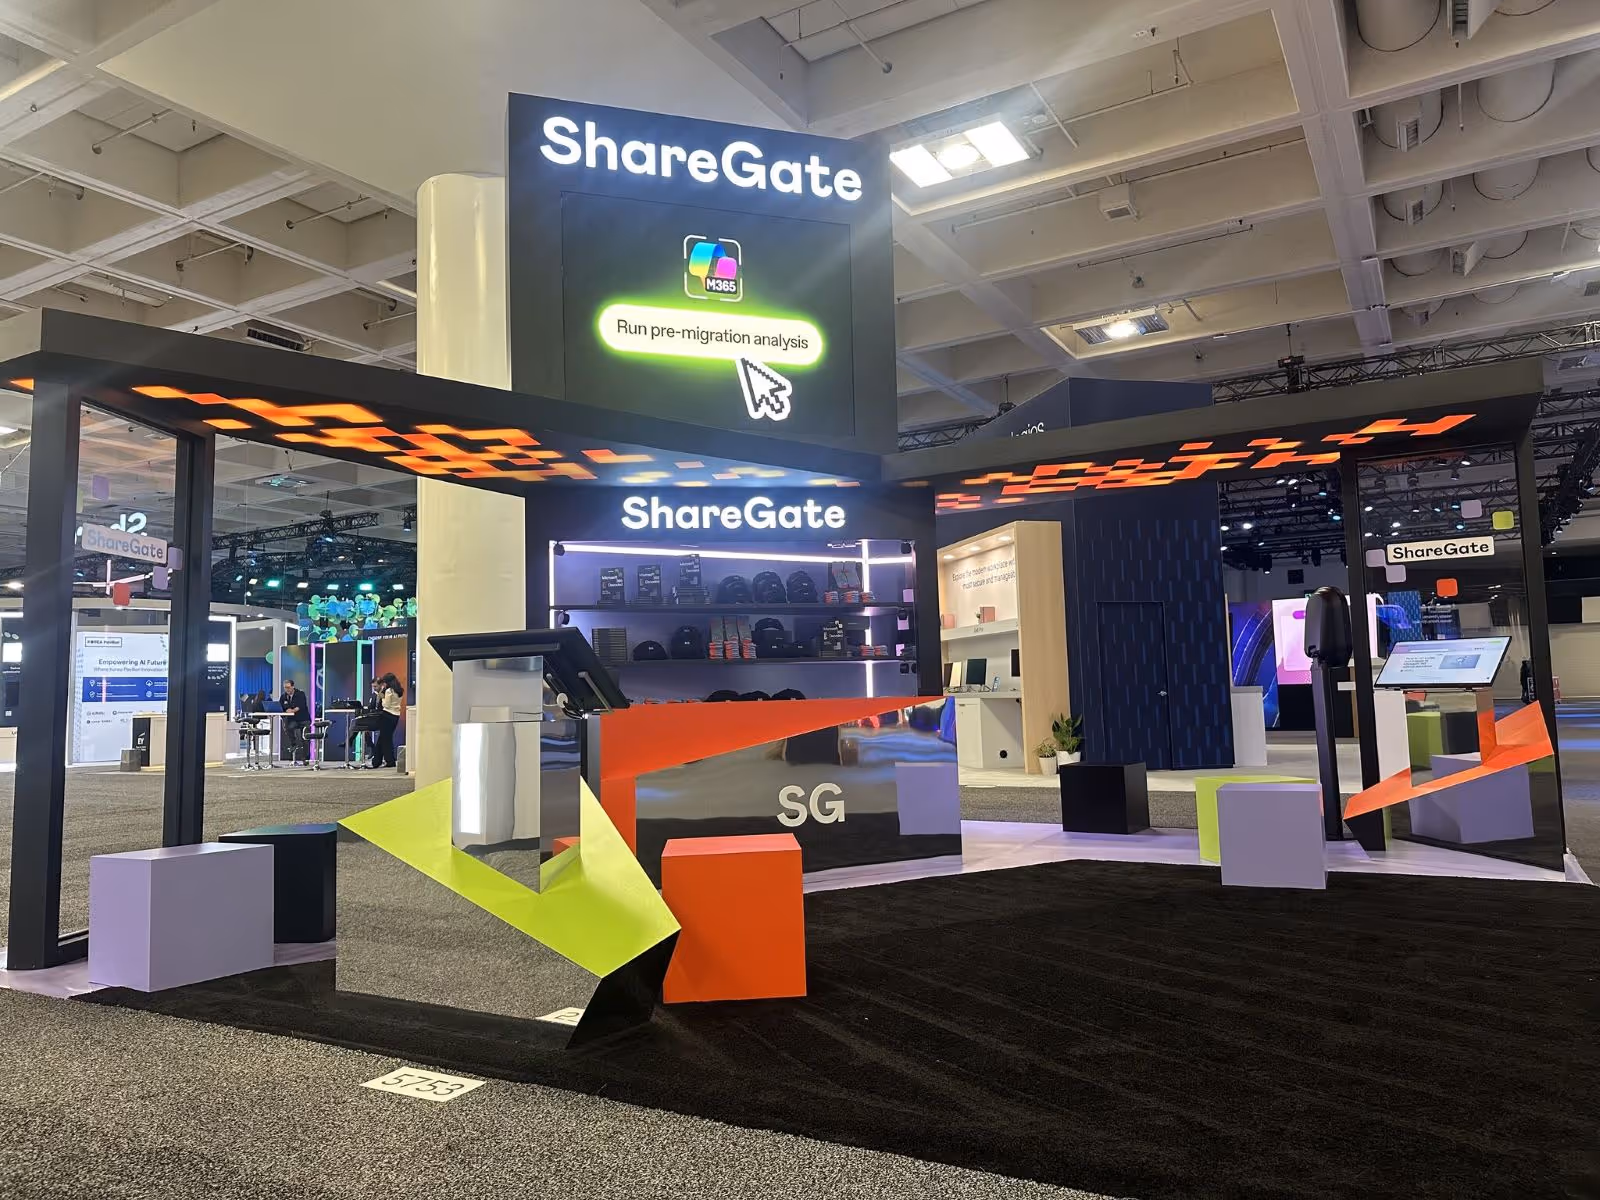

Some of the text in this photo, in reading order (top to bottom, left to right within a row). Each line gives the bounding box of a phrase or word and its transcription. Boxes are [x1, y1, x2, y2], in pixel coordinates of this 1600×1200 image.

[540, 116, 863, 201] ShareGate
[706, 278, 737, 293] M365
[617, 319, 809, 350] Run pre-migration analysis
[621, 496, 846, 530] ShareGate
[87, 529, 164, 559] ShareGate
[1392, 541, 1490, 560] ShareGate
[973, 579, 986, 588] secure
[986, 576, 994, 584] and
[98, 658, 139, 667] Empowering
[776, 782, 846, 827] SG
[381, 1073, 465, 1096] 5753
